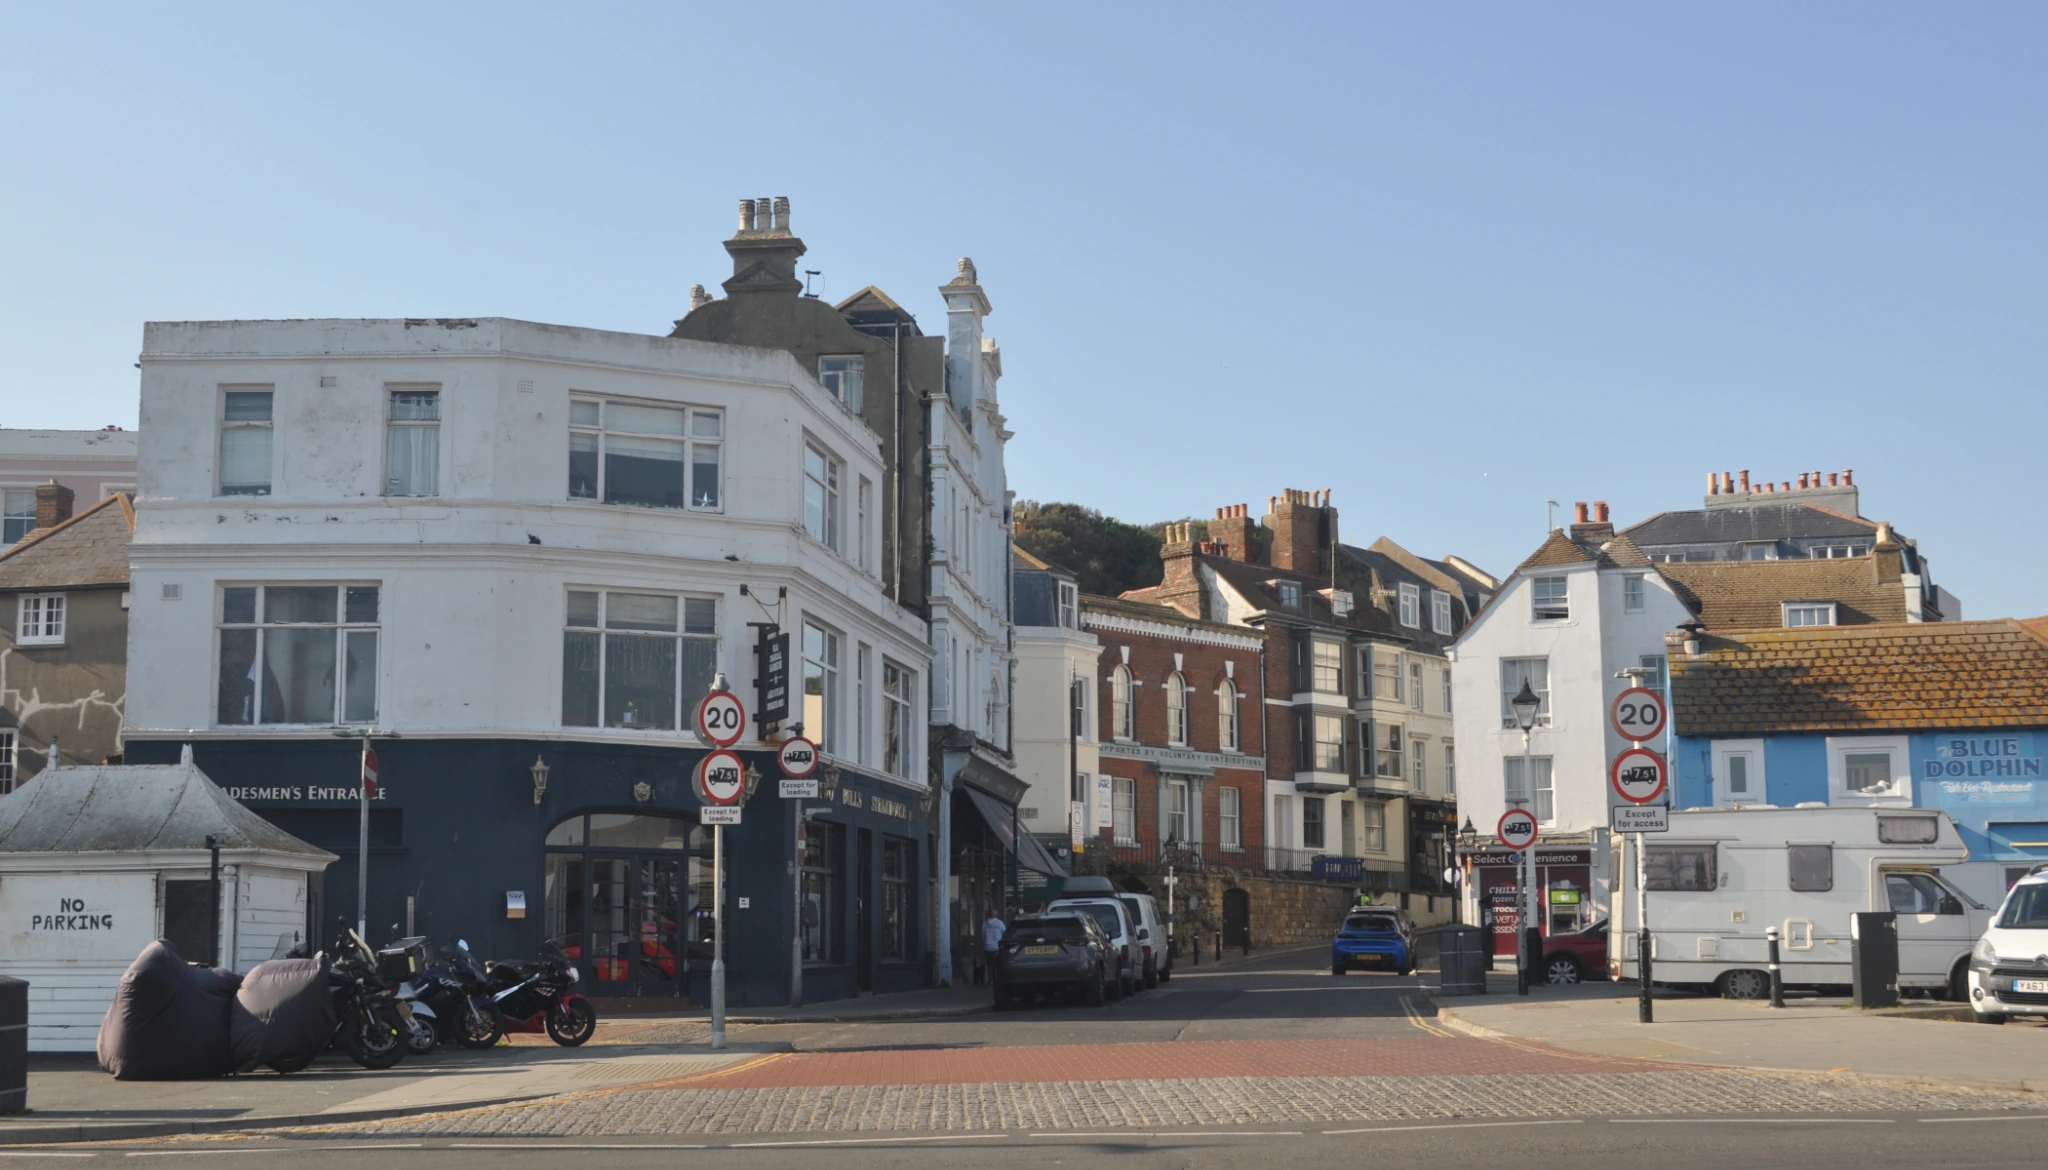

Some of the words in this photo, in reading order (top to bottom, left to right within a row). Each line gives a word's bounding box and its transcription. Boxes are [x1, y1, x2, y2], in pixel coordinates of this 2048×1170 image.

[707, 707, 739, 730] 20
[1619, 703, 1658, 726] 20
[1949, 738, 2019, 758] BLUE
[1160, 750, 1200, 762] VOLUNTARY
[1924, 757, 2042, 779] DOLPHIN
[782, 782, 804, 790] Except
[307, 785, 387, 800] ENTRAE
[786, 789, 811, 797] loading
[704, 808, 727, 817] Except
[1625, 810, 1656, 818] Except
[1618, 819, 1631, 827] for
[1473, 853, 1507, 864] Select
[60, 897, 85, 913] NO
[32, 914, 113, 931] PARKING
[2019, 982, 2044, 992] YA63
